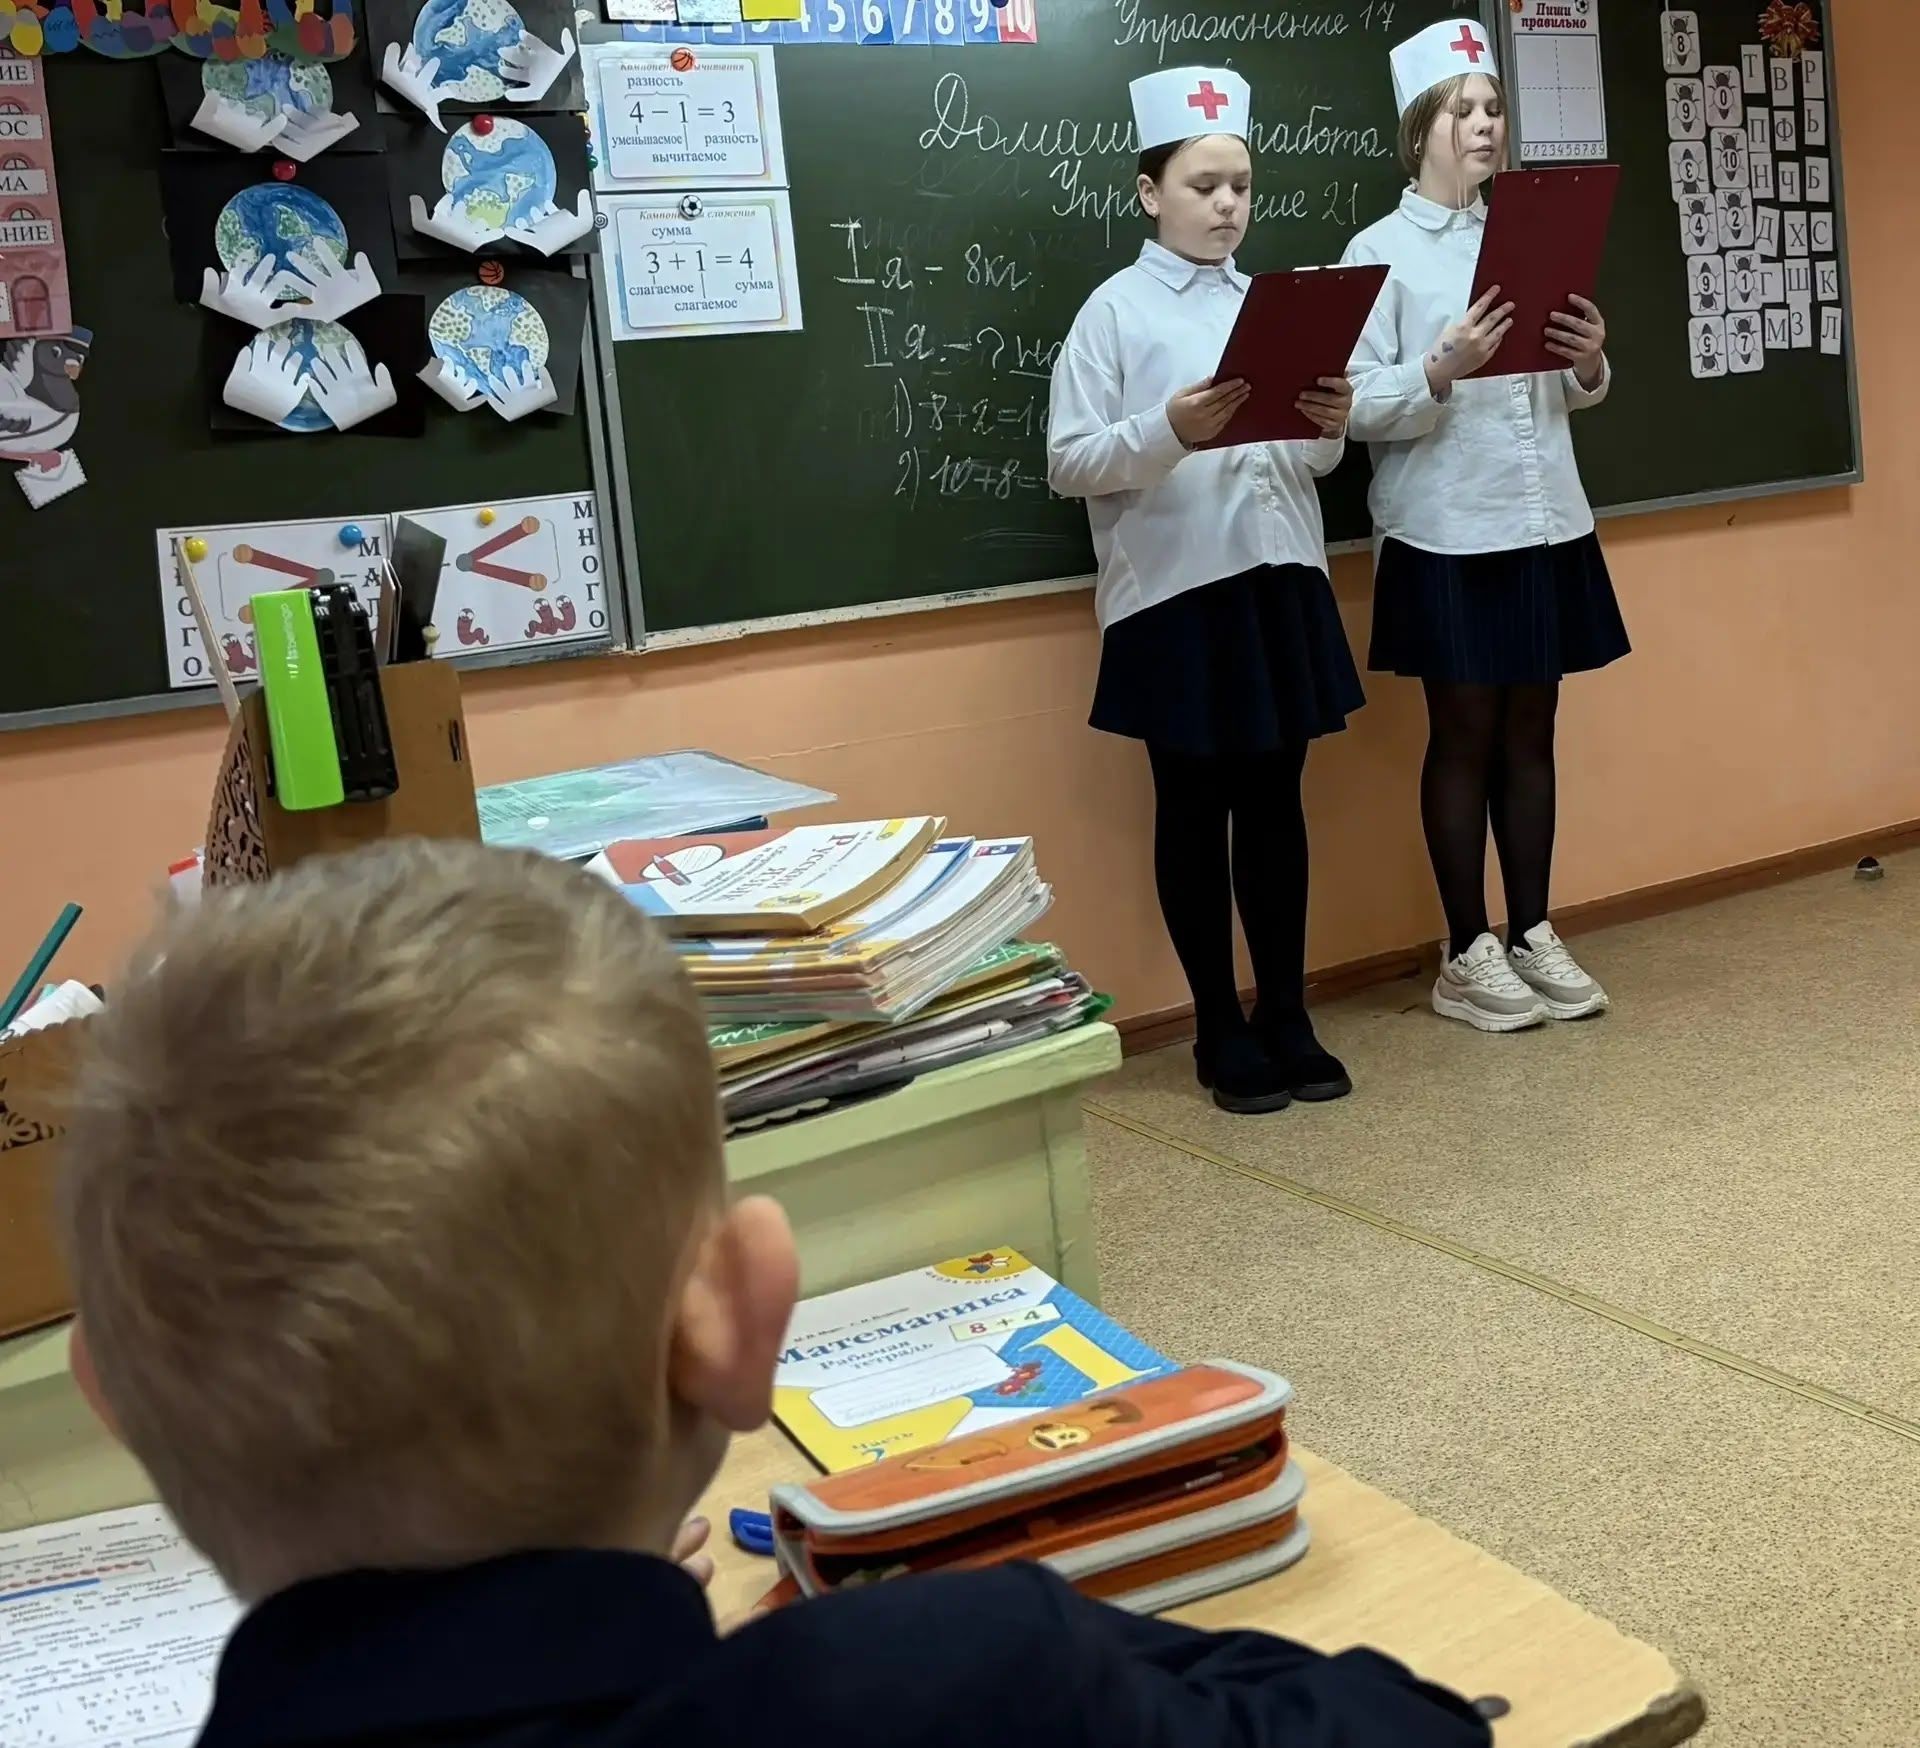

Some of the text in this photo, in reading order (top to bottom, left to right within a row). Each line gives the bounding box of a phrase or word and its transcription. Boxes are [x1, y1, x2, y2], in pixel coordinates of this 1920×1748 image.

[862, 0, 884, 35] 6
[935, 0, 956, 36] 8
[970, 0, 990, 34] 9
[1005, 0, 1035, 33] 10
[1359, 1, 1396, 32] 17
[1536, 2, 1572, 16] Пиши
[1521, 17, 1588, 31] правильно
[1677, 35, 1685, 53] 8
[1743, 53, 1758, 78] Т
[1804, 60, 1816, 84] Р
[627, 76, 684, 89] разность
[1772, 66, 1788, 91] В
[1719, 89, 1728, 106] 0
[629, 101, 645, 124] 4
[679, 101, 689, 123] 1
[697, 107, 715, 116] =
[721, 101, 736, 124] 3
[919, 72, 1143, 156] Домаш
[1682, 102, 1690, 120] 9
[1806, 109, 1819, 133] Ь
[612, 132, 758, 148] уменьшаемое разность
[1750, 118, 1766, 143] П
[1775, 117, 1794, 142] Ф
[652, 152, 727, 163] вычитаемое
[1723, 152, 1737, 169] 10
[1753, 164, 1769, 189] Н
[1781, 170, 1795, 195] Ч
[1807, 165, 1820, 190] Б
[707, 209, 756, 219] сложения
[1321, 181, 1359, 226] 21
[1695, 217, 1703, 233] 4
[1732, 210, 1740, 228] 2
[0, 225, 49, 242] НИЕ
[652, 226, 692, 238] сумма
[1756, 216, 1774, 248] Д
[1789, 223, 1806, 247] Х
[1812, 220, 1827, 245] С
[646, 247, 754, 274] 3 + 1 = 4
[629, 280, 774, 297] слагаемое сумма
[1741, 272, 1748, 290] 1
[1760, 271, 1773, 296] Г
[1787, 267, 1809, 292] Ш
[1820, 270, 1836, 294] К
[674, 299, 738, 312] слагаемое
[1767, 318, 1786, 342] М
[1822, 316, 1839, 340] Л
[1741, 335, 1749, 352] 7
[572, 499, 606, 629] МНОГО
[968, 1322, 987, 1335] 8
[1024, 1309, 1041, 1322] 4
